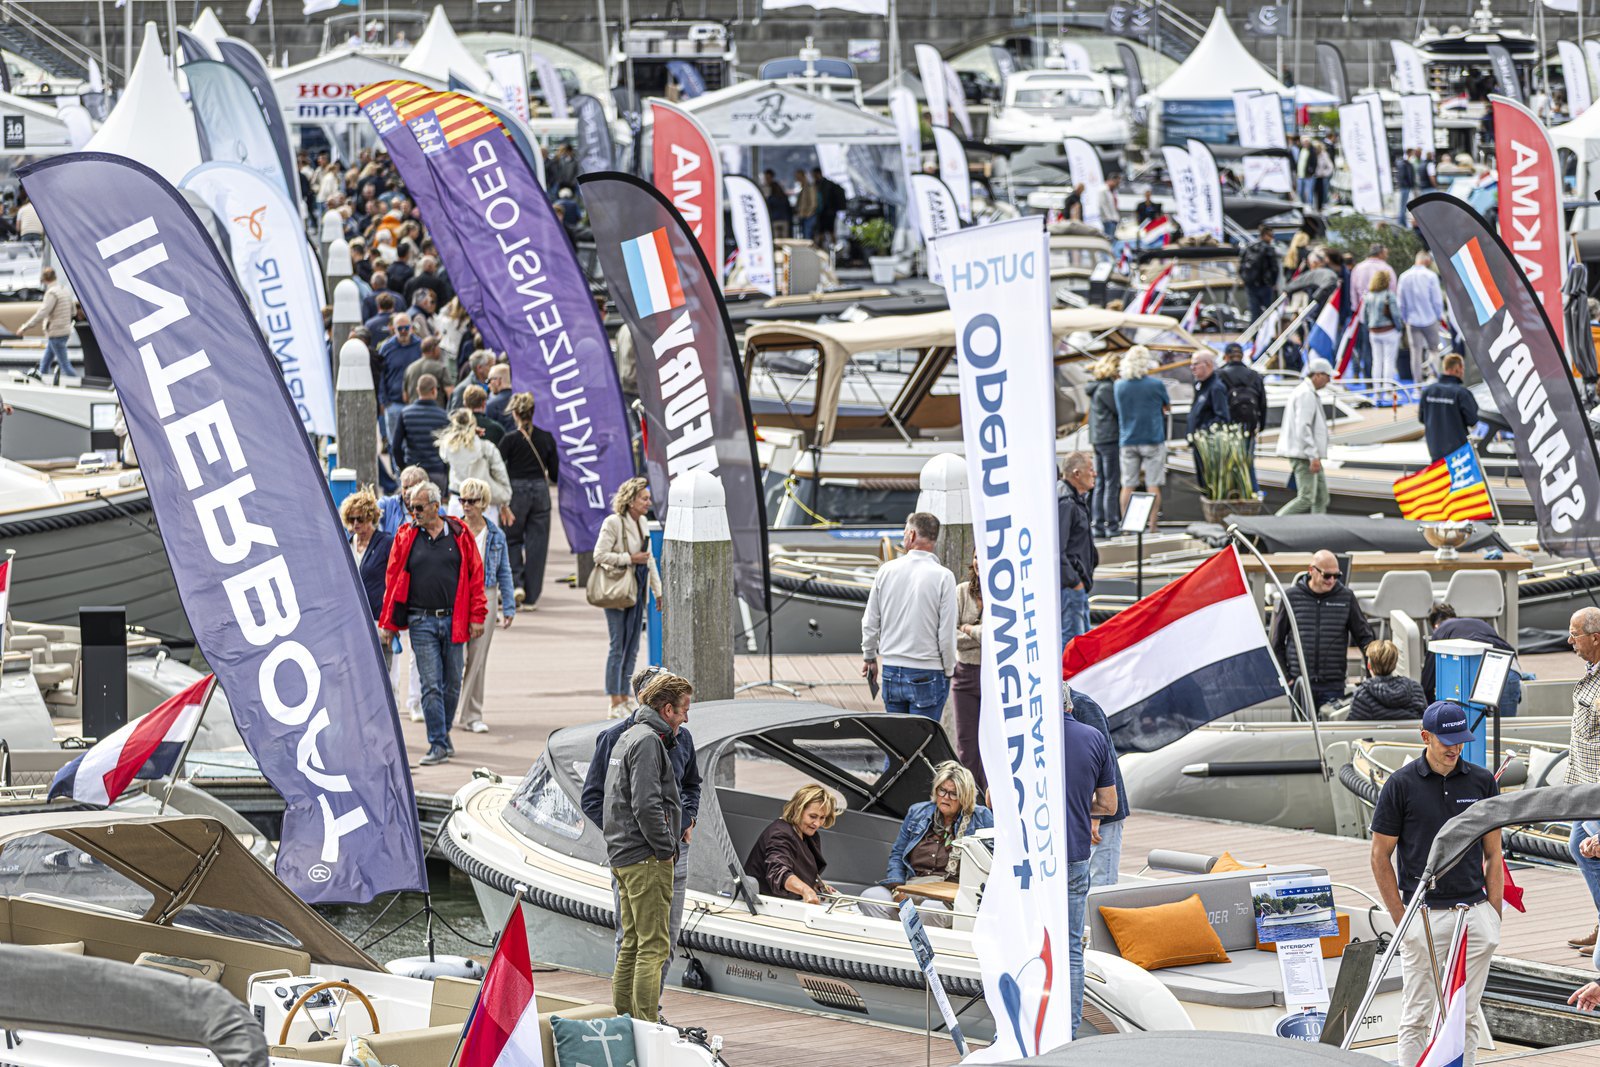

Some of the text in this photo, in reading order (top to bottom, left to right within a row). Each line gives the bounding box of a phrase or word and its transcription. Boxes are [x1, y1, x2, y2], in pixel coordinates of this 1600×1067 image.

[298, 84, 364, 98] HON
[299, 104, 362, 117] MAR
[1208, 910, 1229, 925] DER
[1304, 1022, 1321, 1036] 10
